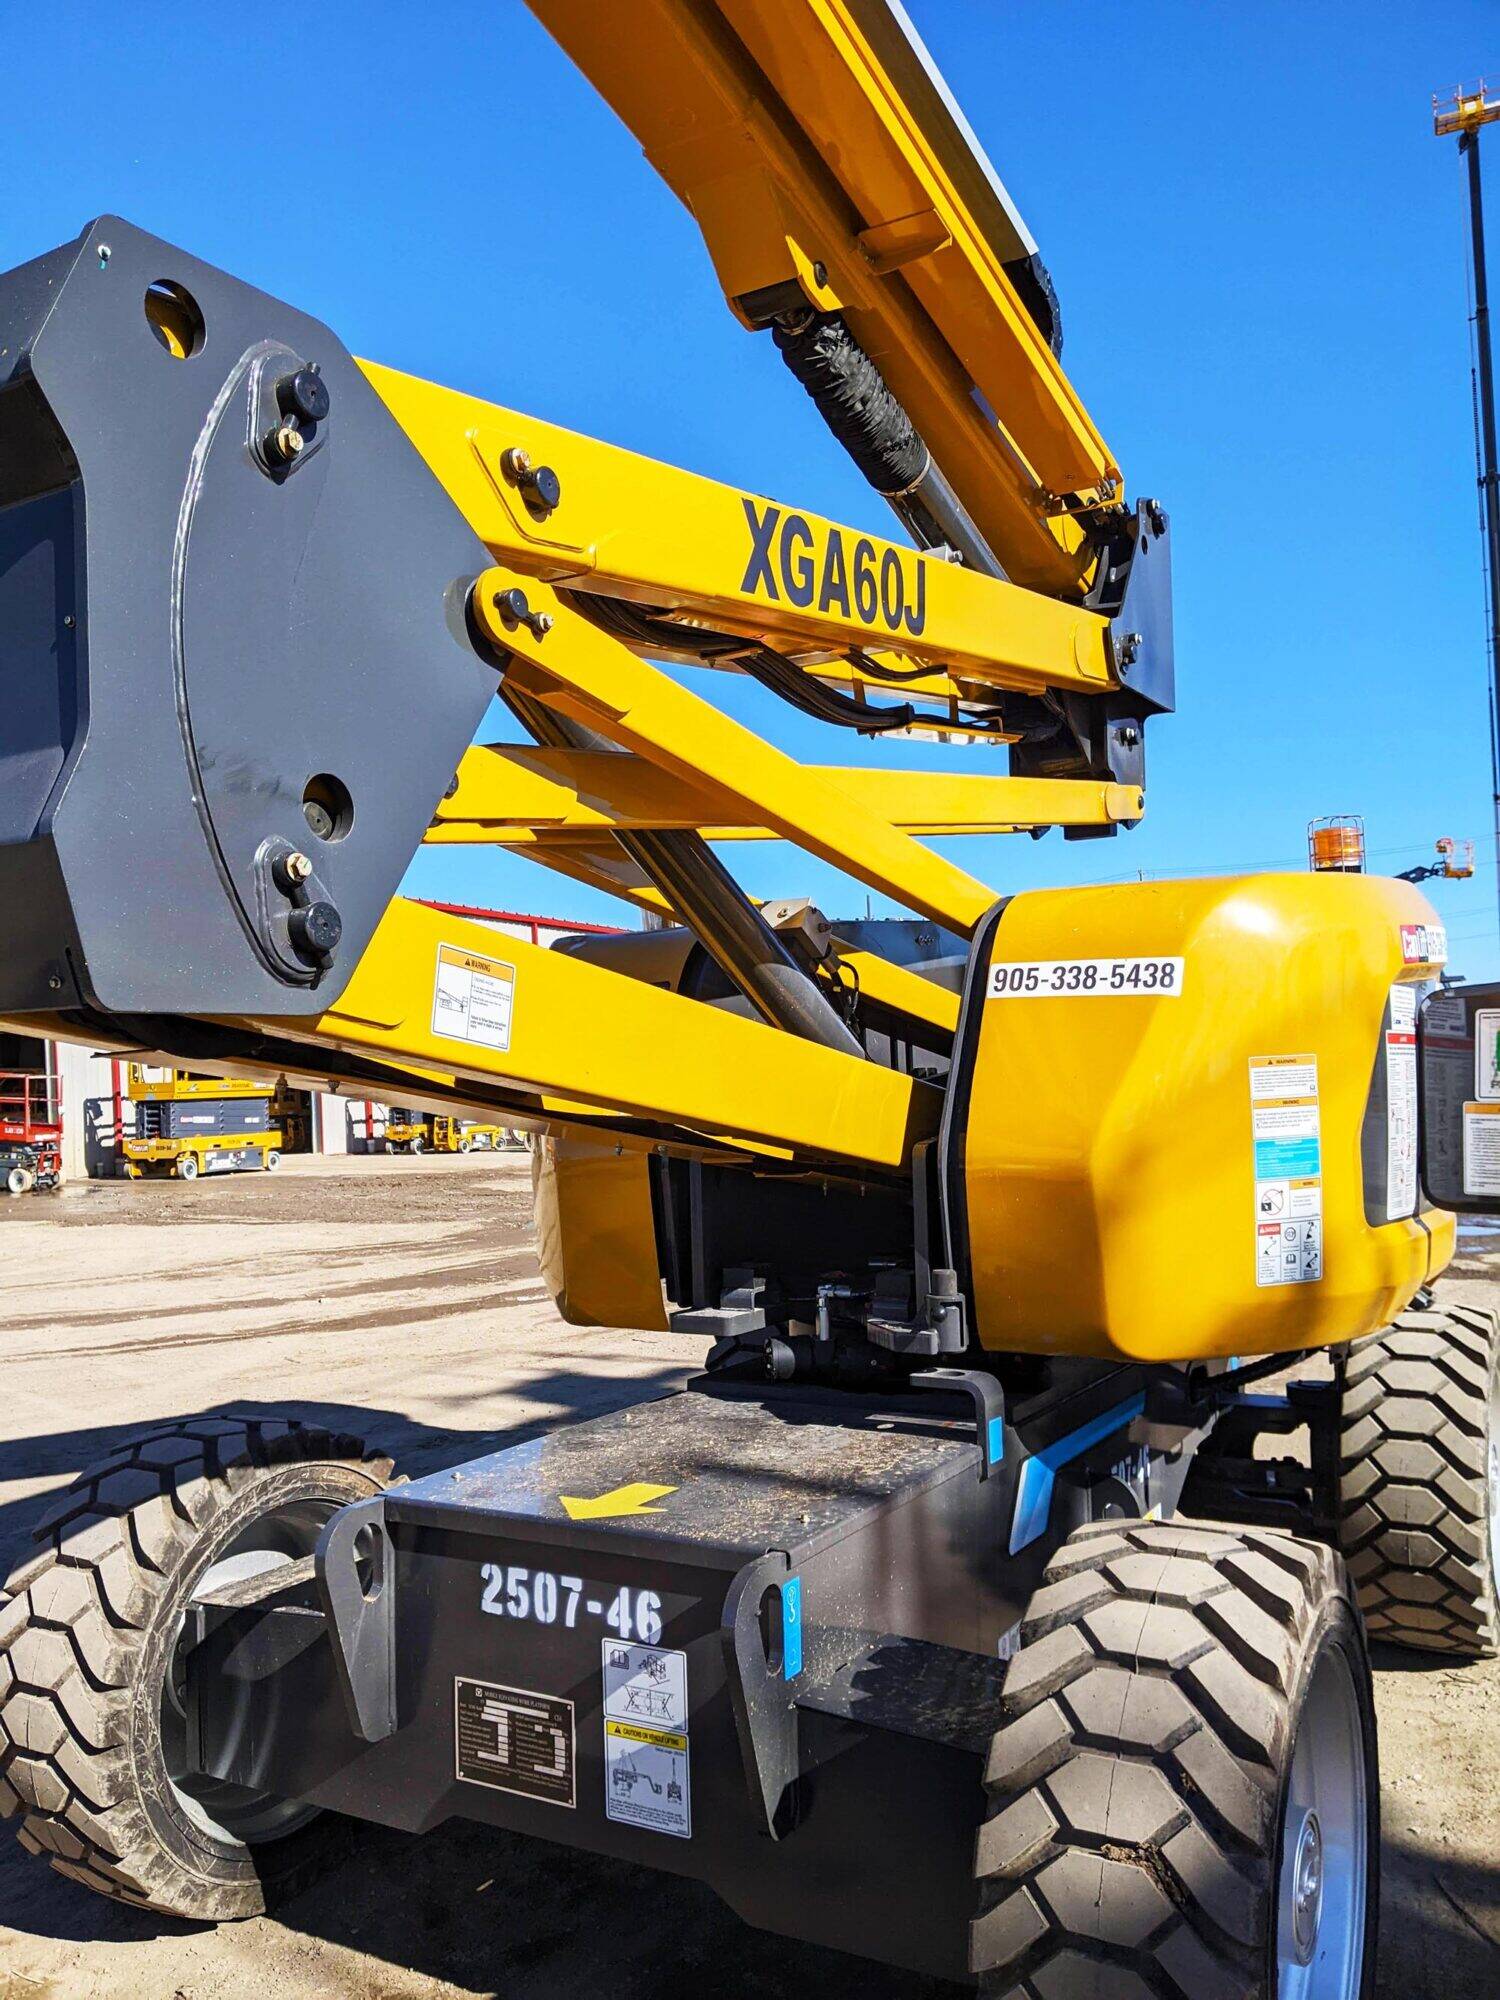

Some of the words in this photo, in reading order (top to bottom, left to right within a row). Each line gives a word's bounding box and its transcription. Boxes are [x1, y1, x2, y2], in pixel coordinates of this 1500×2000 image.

[740, 498, 926, 637] XGA60J
[471, 960, 491, 973] WARNING
[993, 962, 1176, 993] 905-338-5438
[480, 1563, 662, 1645] 2507-46
